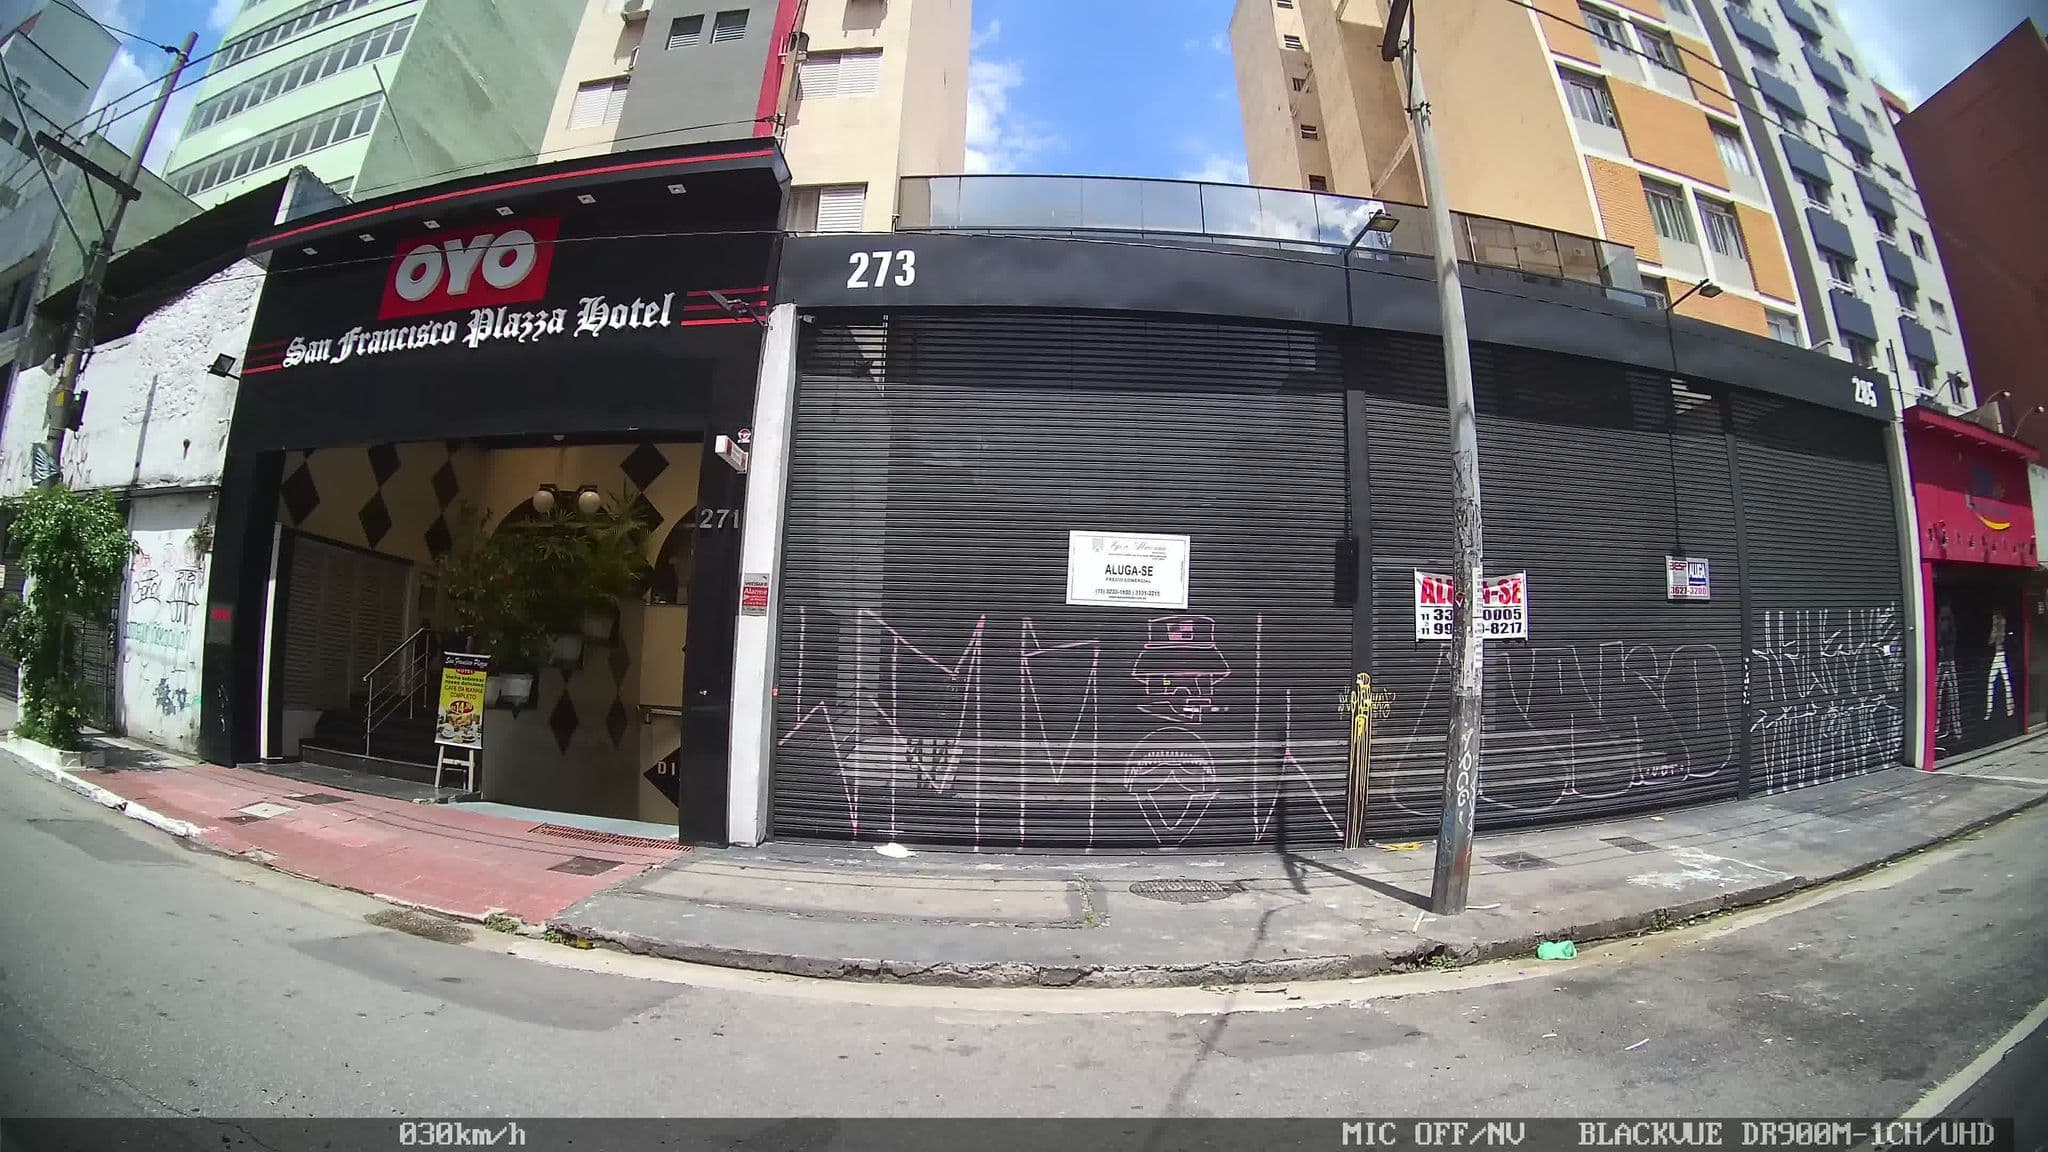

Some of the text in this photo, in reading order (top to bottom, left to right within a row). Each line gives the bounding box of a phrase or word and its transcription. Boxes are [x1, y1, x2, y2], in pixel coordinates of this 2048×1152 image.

[395, 229, 537, 302] OYO
[846, 249, 916, 289] 273
[282, 292, 677, 369] San Francisco Plazza Hotel
[700, 509, 741, 529] 271
[1105, 564, 1154, 577] ALUGA-SE
[1420, 613, 1430, 621] 11
[1420, 627, 1430, 635] 11
